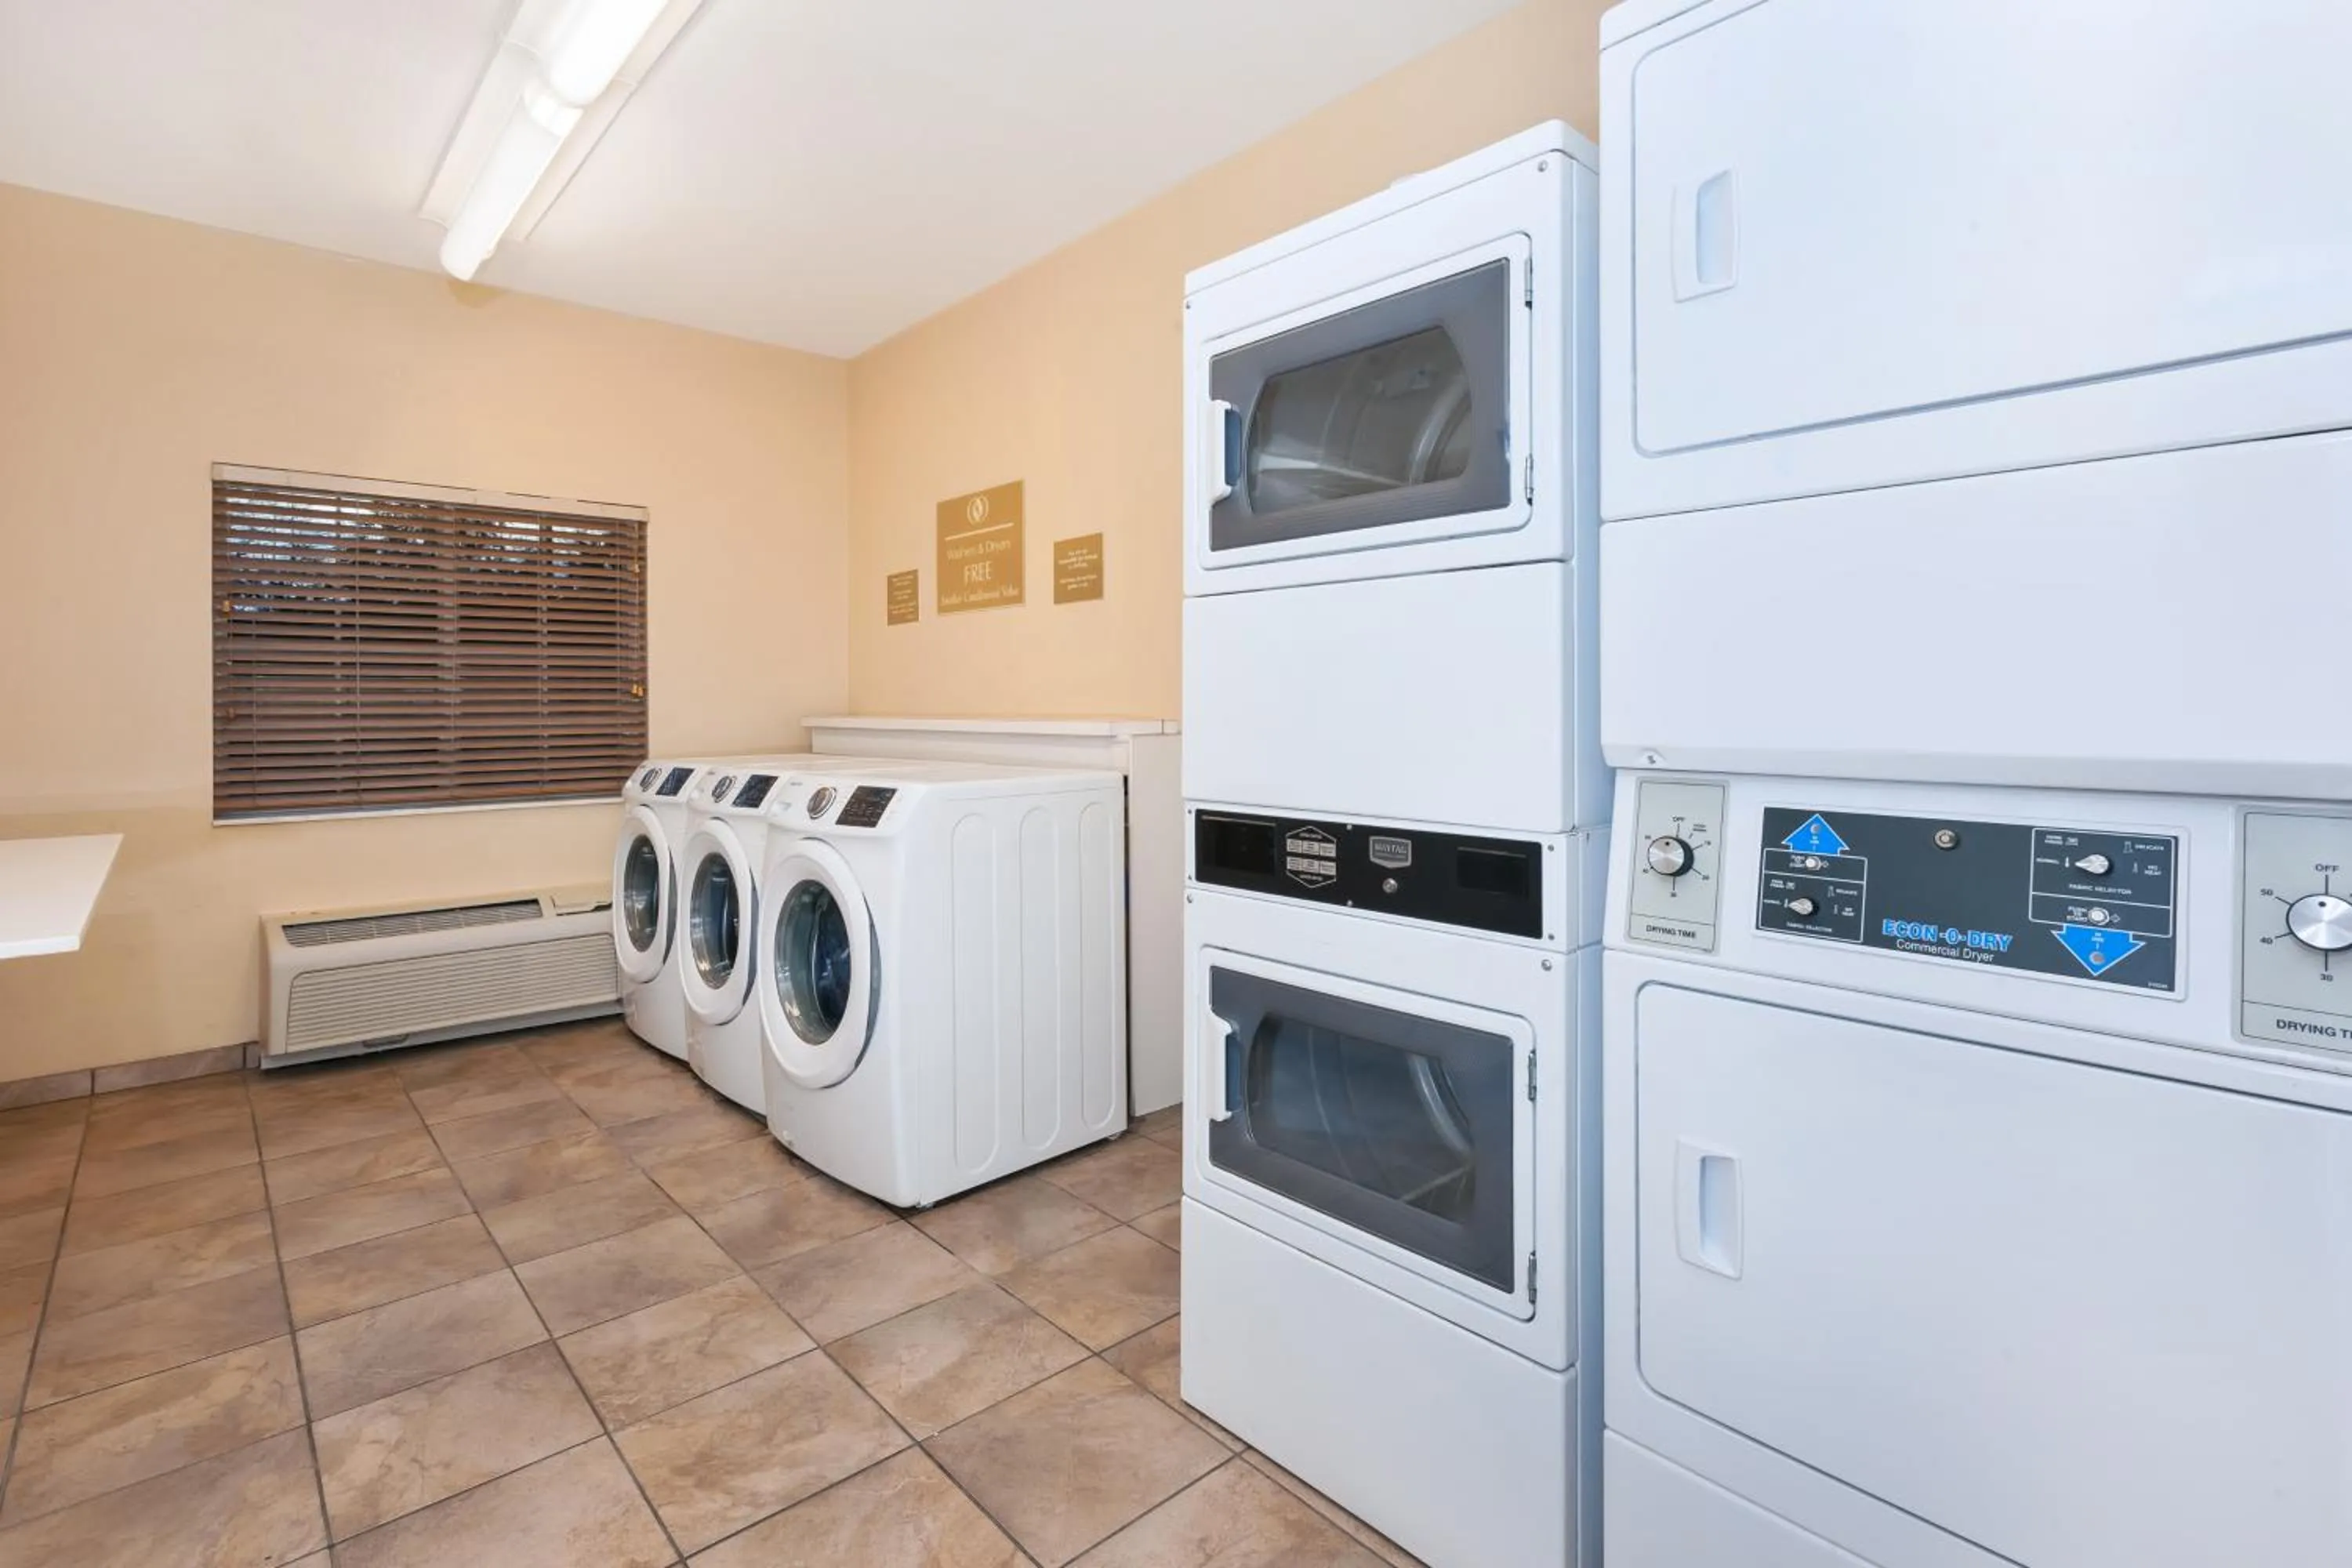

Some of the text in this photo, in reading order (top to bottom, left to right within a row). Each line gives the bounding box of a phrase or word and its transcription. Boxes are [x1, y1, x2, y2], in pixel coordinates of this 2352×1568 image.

[964, 561, 993, 586] FREE
[1374, 843, 1406, 854] MAYTAG
[2315, 863, 2340, 873] OFF
[1646, 924, 1696, 938] DRYING TIME
[2259, 936, 2274, 945] 40
[1896, 938, 1995, 964] Commercial Dryer
[2320, 973, 2333, 982] 30
[2276, 1018, 2337, 1037] DRYING
